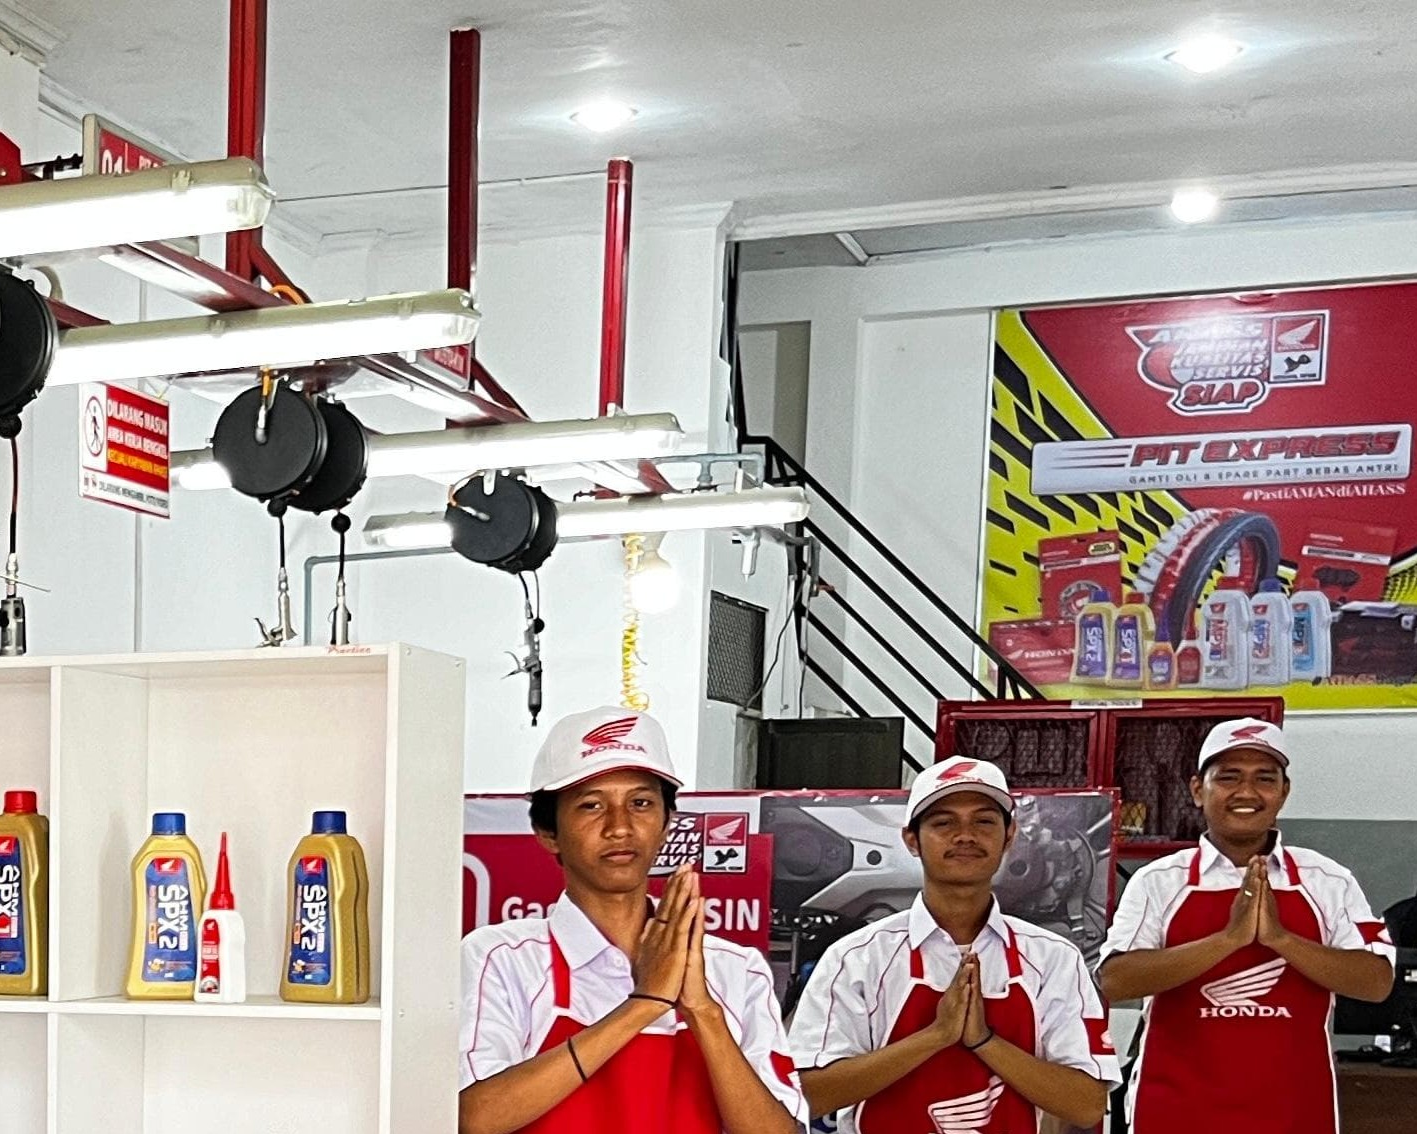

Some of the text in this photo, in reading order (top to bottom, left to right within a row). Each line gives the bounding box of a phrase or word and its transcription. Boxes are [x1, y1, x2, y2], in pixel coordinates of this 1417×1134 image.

[1181, 380, 1260, 406] SIAP
[1130, 431, 1401, 468] PIT EXPRESS
[1175, 473, 1198, 483] OLI
[1266, 467, 1299, 478] PART
[581, 743, 648, 759] HONDA
[1199, 1005, 1293, 1019] HONDA
